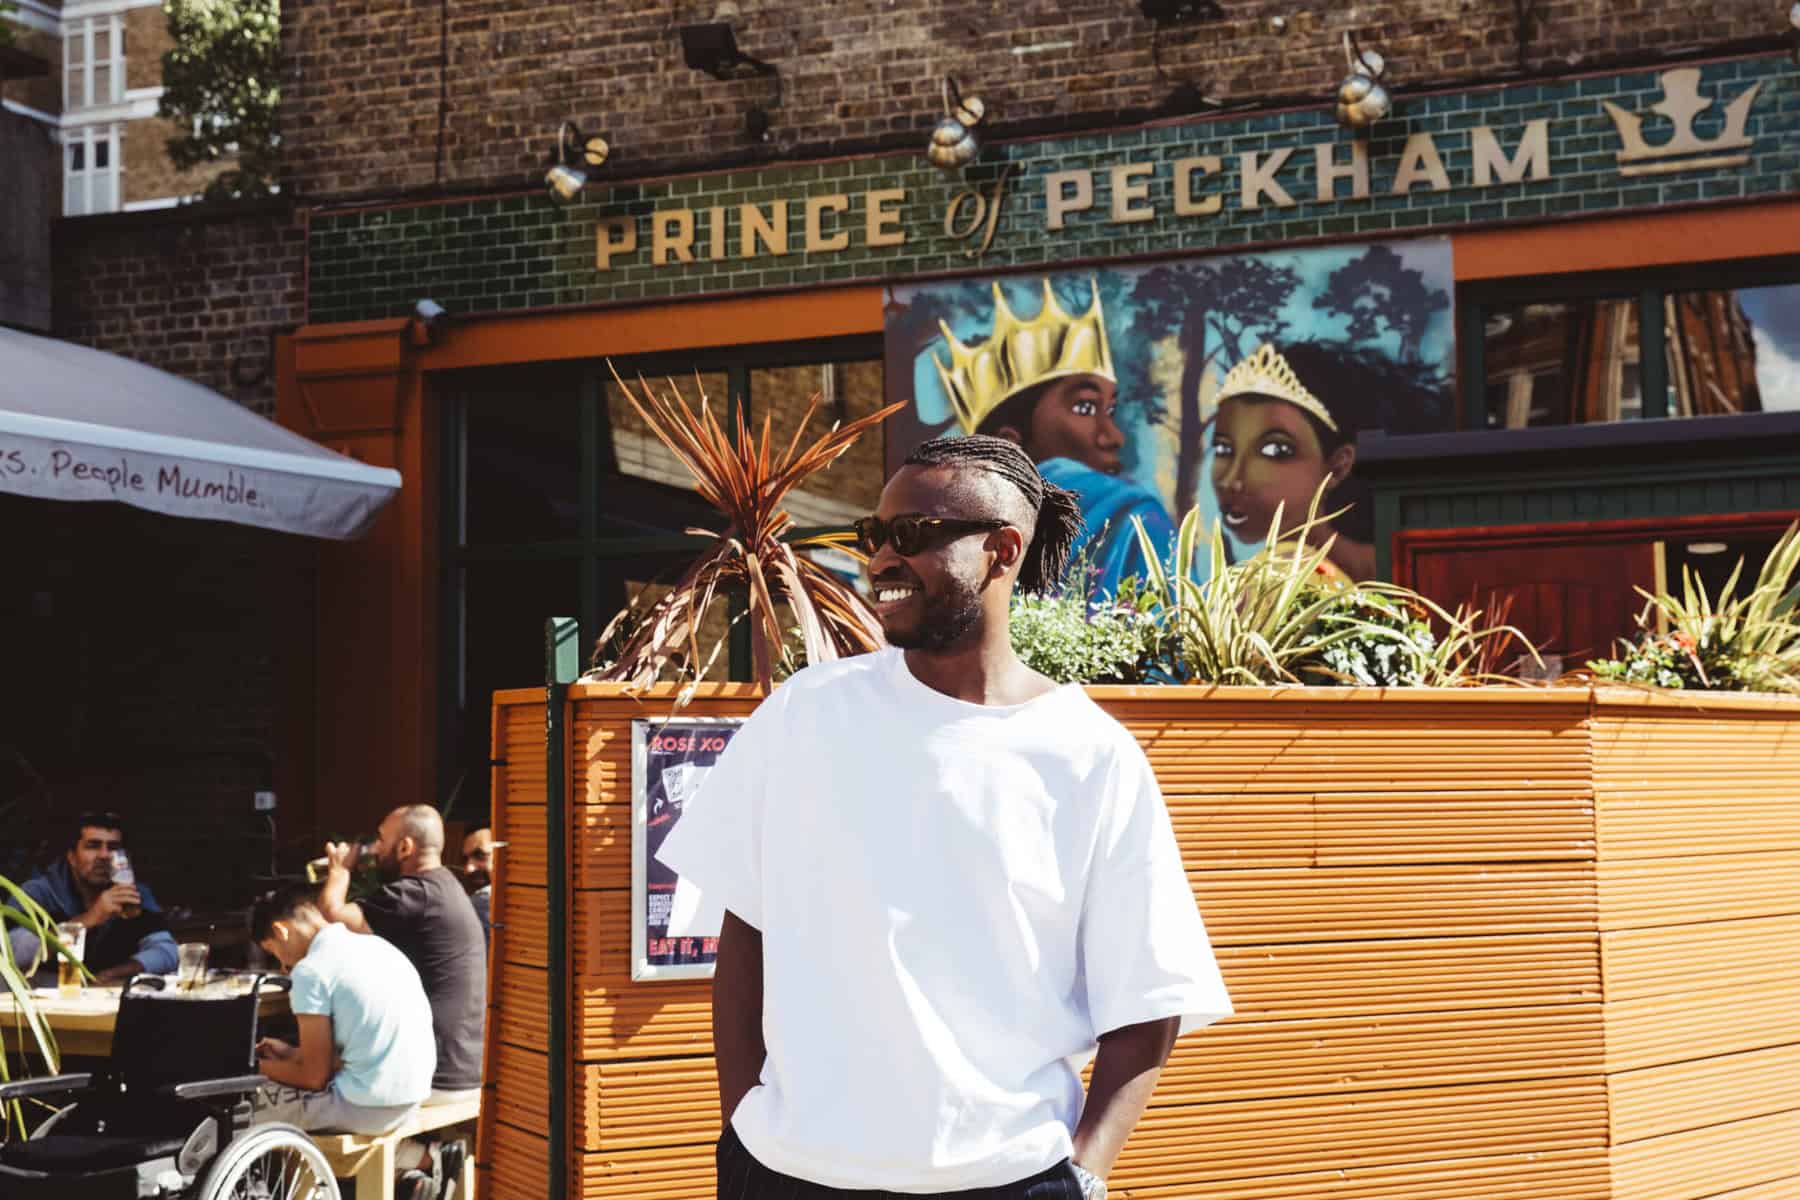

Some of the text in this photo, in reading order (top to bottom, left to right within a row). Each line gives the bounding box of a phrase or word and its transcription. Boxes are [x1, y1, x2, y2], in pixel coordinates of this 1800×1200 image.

[594, 118, 1551, 271] PRINCE of PECKHAM
[51, 449, 145, 494] People
[652, 735, 696, 752] ROSE
[648, 938, 677, 956] EAT
